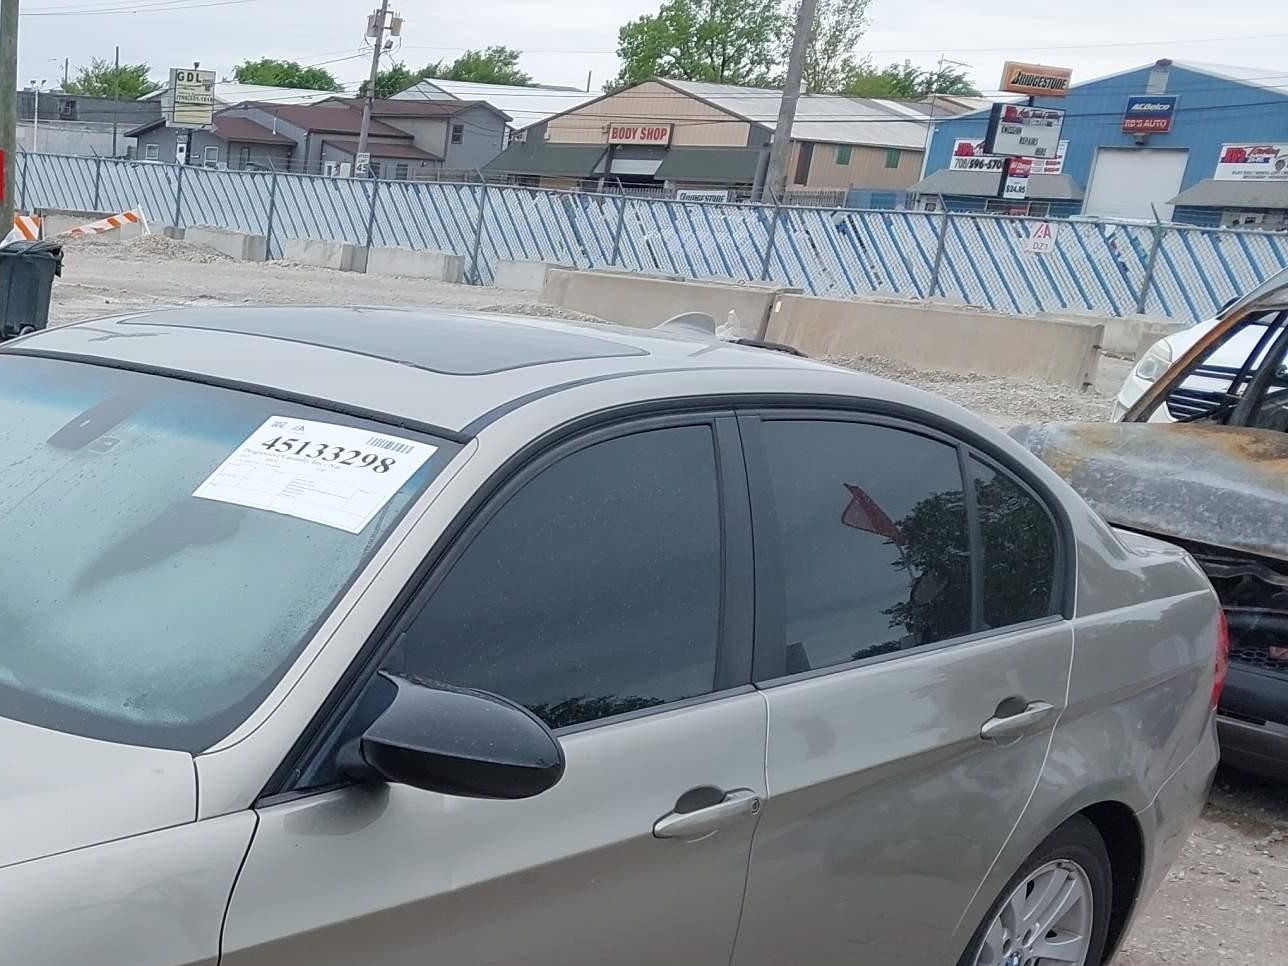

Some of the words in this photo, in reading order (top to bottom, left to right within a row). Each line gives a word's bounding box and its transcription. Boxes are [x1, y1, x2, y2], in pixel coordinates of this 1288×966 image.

[1143, 119, 1167, 128] AUTO
[612, 127, 638, 140] BODY
[640, 127, 668, 141] SHOP
[356, 163, 368, 172] 45
[261, 436, 396, 474] 45133298
